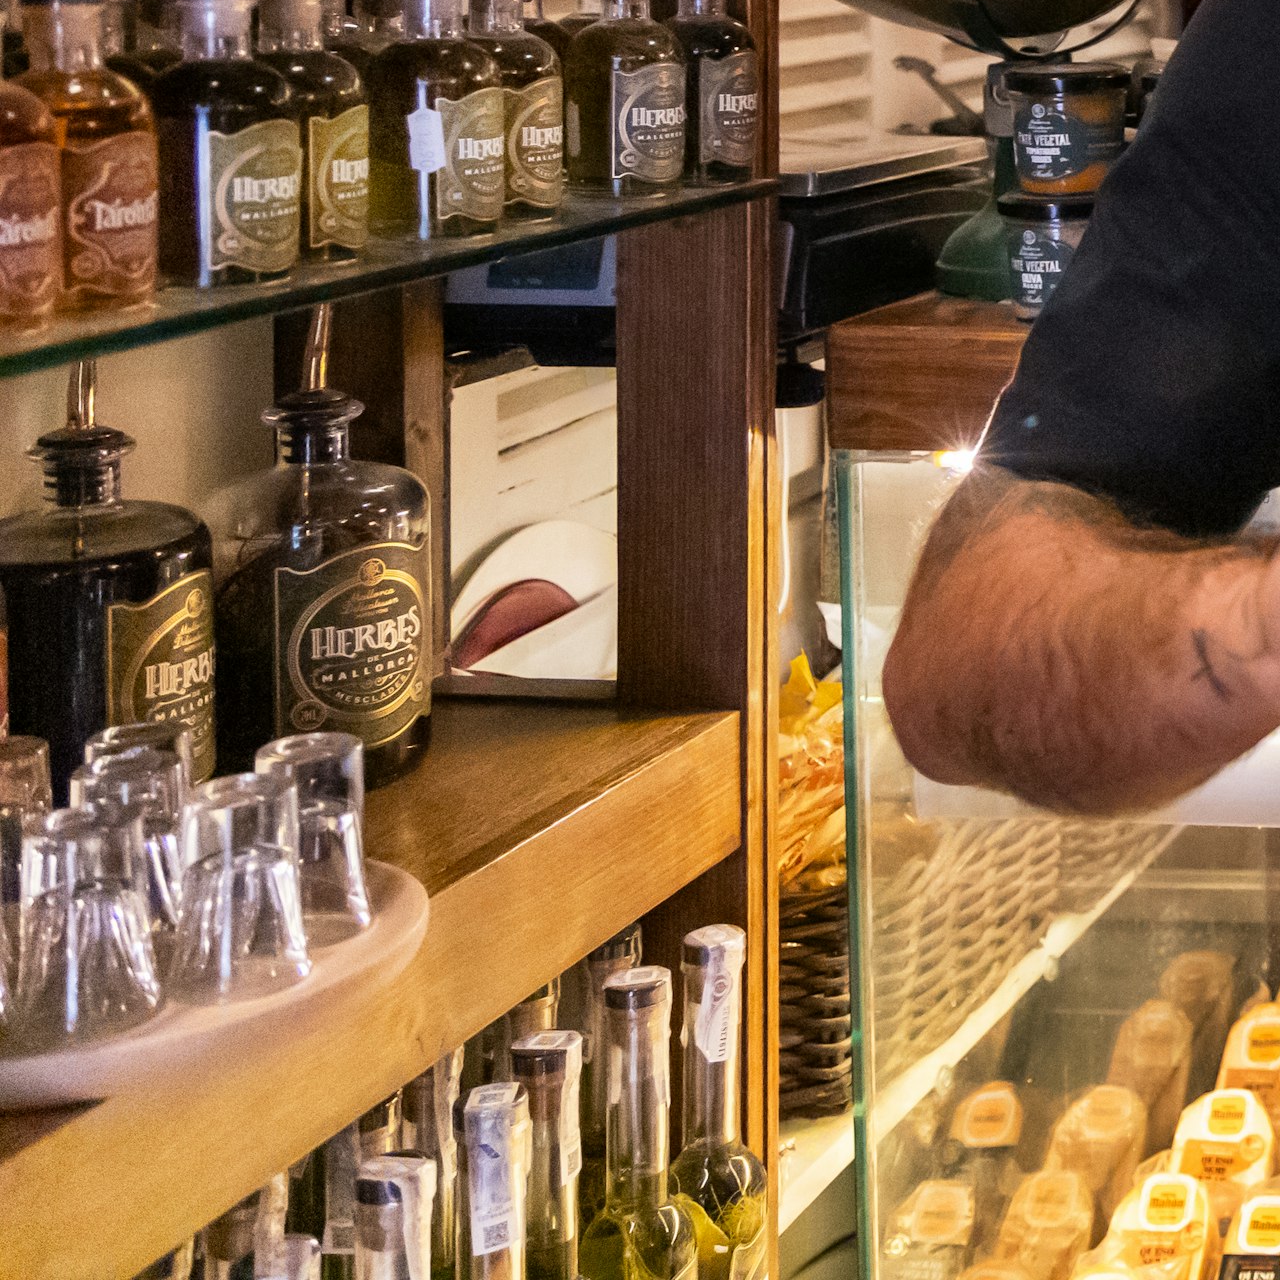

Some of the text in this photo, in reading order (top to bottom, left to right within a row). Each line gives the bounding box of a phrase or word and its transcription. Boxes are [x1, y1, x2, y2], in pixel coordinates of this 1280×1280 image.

[1034, 133, 1071, 147] VEGETAL
[1025, 260, 1062, 273] VEGETAL
[310, 604, 421, 661] HERBES
[321, 654, 415, 684] MALLORCA
